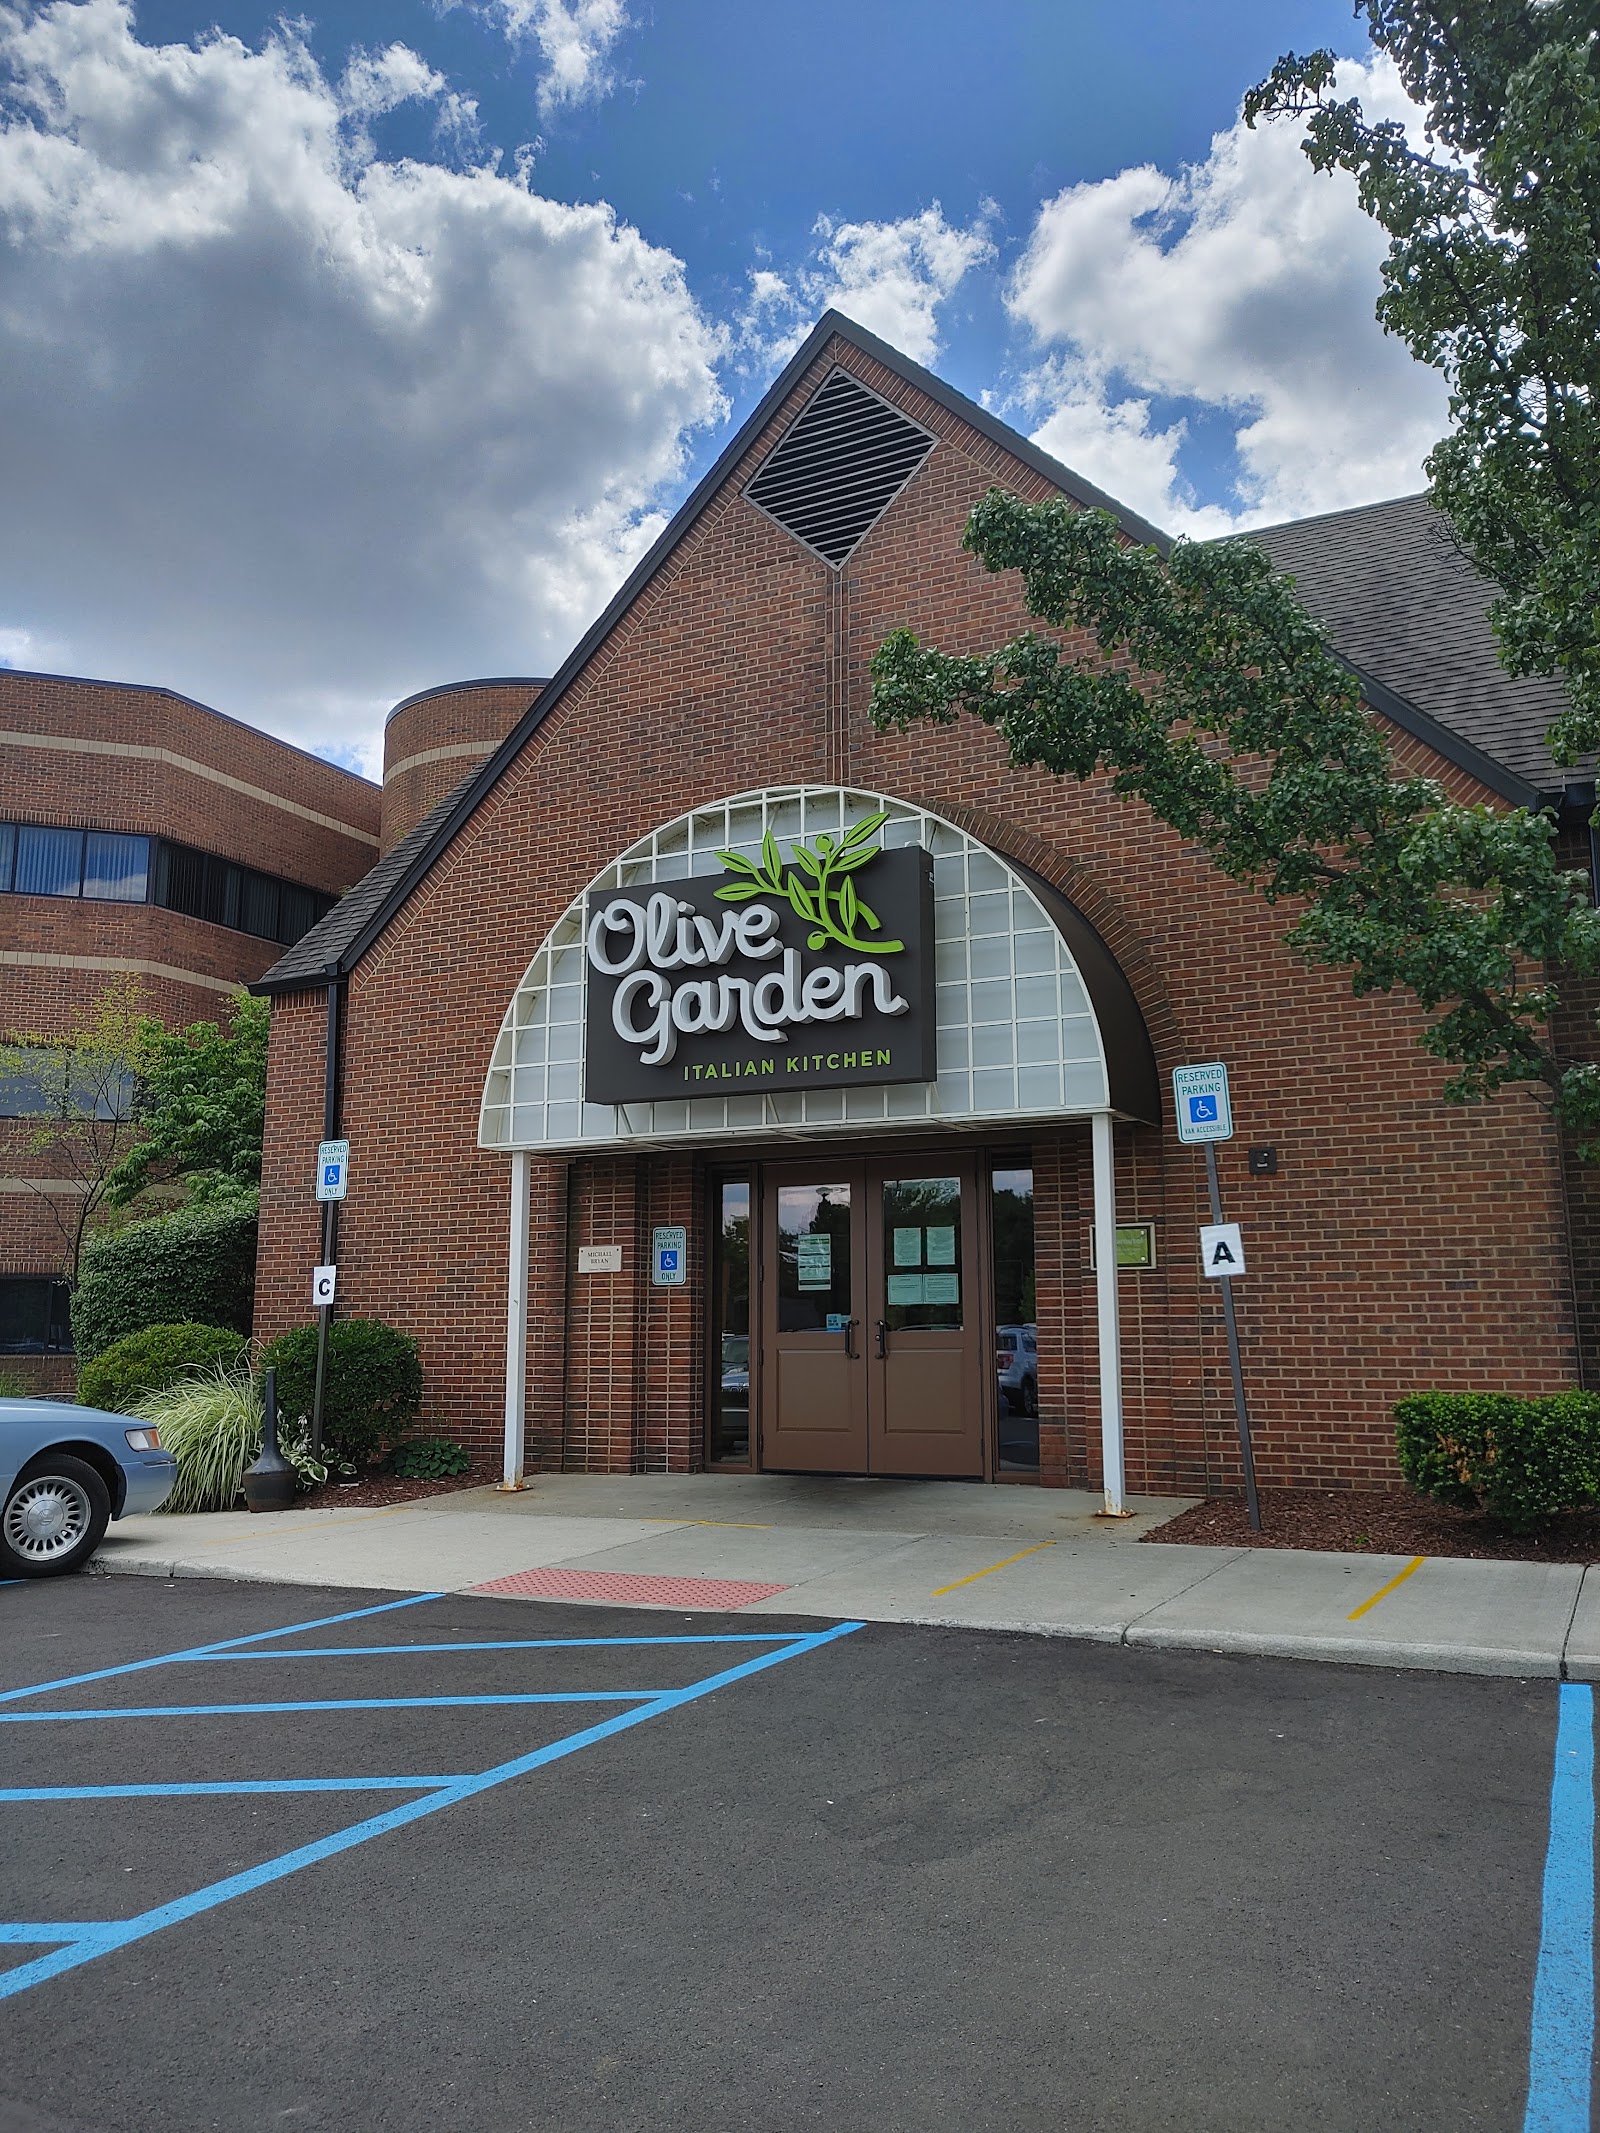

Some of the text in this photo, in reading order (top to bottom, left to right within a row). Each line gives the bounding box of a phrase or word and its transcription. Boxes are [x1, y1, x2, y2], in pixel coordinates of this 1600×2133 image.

[588, 892, 784, 978] Olive
[612, 948, 910, 1066] Garden
[683, 1049, 892, 1081] ITALIAN KITCHEN
[1178, 1069, 1222, 1083] RESERVED
[1182, 1083, 1221, 1095] PARKING
[1184, 1123, 1227, 1135] VAN ACCESSIBLE
[321, 1144, 347, 1154] RESERVED
[322, 1154, 345, 1164] PARKING
[324, 1187, 338, 1196] ONLY
[656, 1231, 683, 1240] RESERVED
[657, 1241, 682, 1250] PARKING
[1212, 1241, 1236, 1265] A
[661, 1272, 676, 1281] ONLY
[318, 1278, 331, 1297] C
